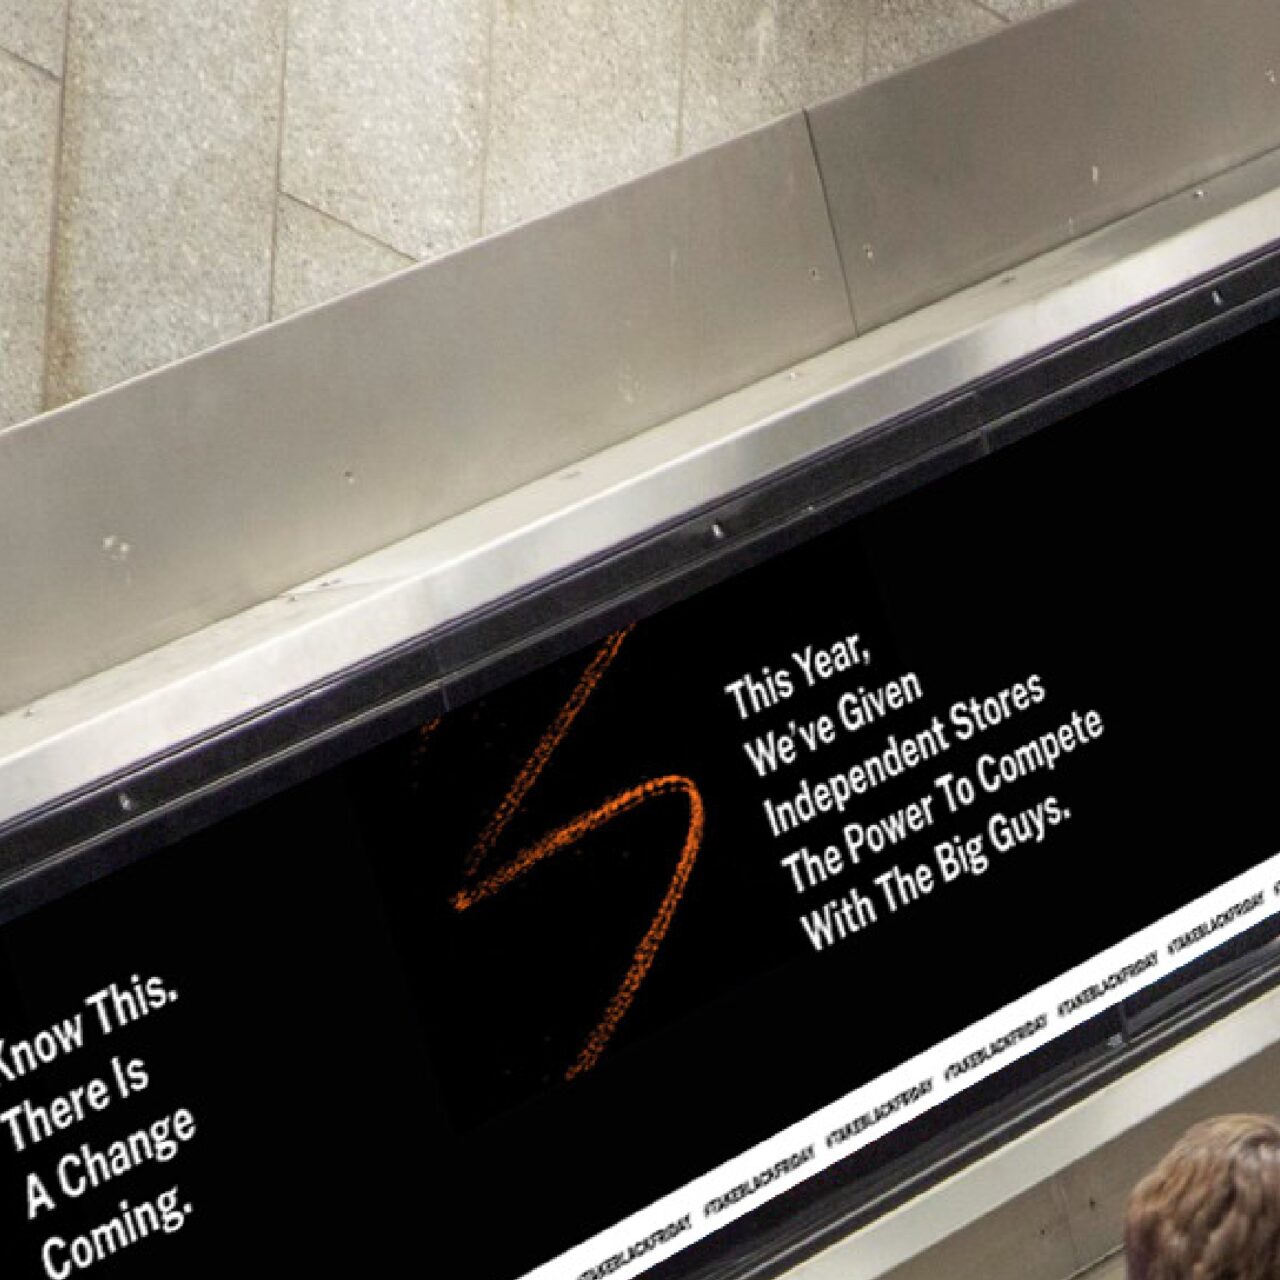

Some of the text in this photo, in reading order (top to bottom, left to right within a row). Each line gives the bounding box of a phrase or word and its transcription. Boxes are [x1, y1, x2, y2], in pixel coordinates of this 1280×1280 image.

[724, 634, 870, 719] This Year,
[744, 672, 923, 776] We've Given
[764, 674, 1045, 836] Independent Stores
[781, 710, 1104, 893] The Power To Compete
[800, 796, 1071, 950] With The Big Guys.
[85, 974, 178, 1034] This.
[0, 1056, 149, 1151] There Is
[27, 1109, 196, 1219] A Change
[42, 1187, 192, 1280] Coming.
